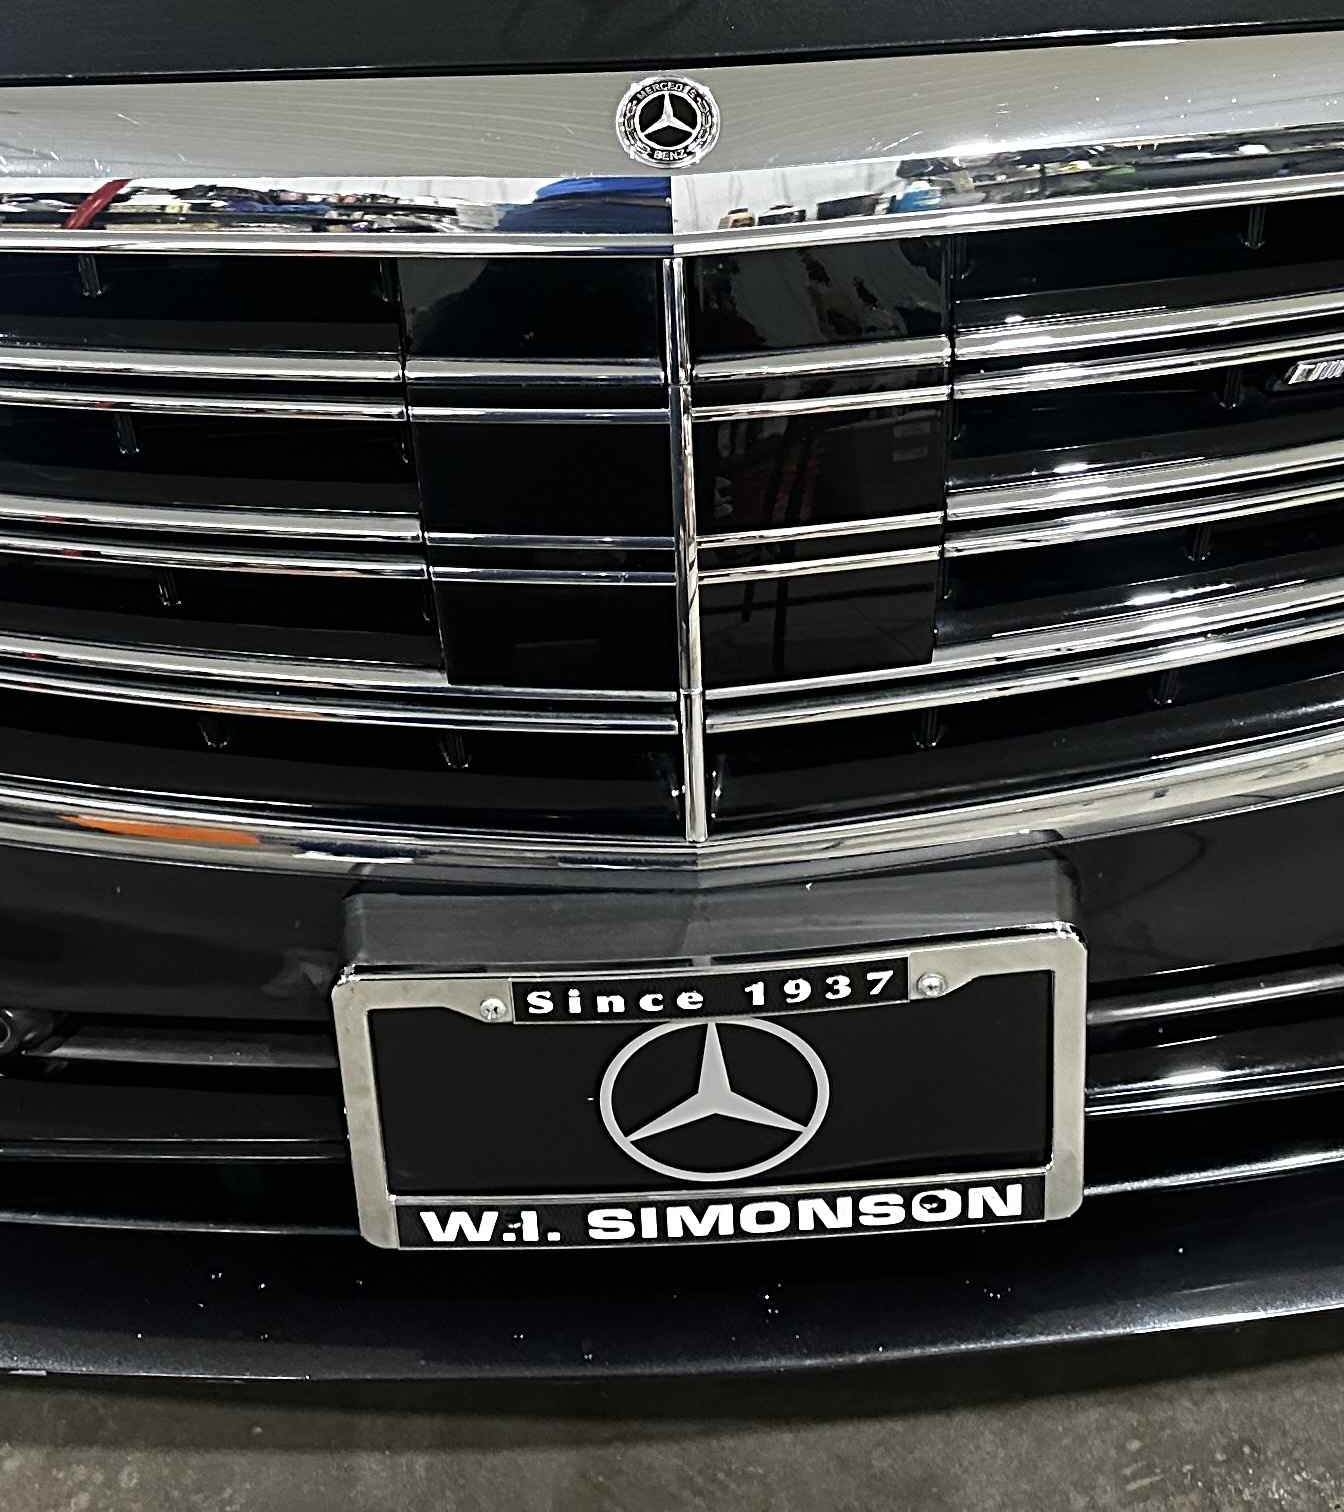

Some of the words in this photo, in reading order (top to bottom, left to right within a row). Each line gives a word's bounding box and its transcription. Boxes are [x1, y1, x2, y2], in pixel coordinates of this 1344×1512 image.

[653, 149, 687, 161] BENZ
[526, 988, 704, 1015] Since
[743, 970, 895, 1006] 1937
[419, 1210, 561, 1242] W.I.
[587, 1183, 1023, 1240] SIMONSON
